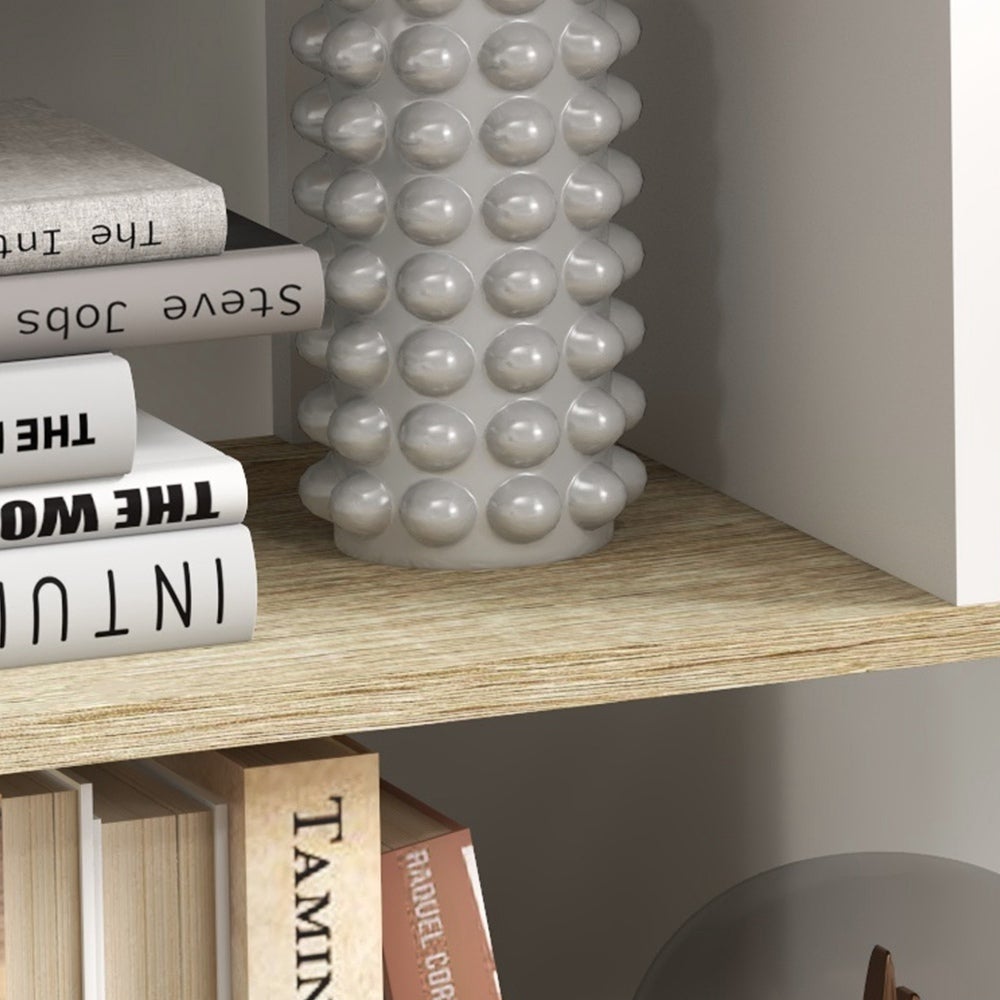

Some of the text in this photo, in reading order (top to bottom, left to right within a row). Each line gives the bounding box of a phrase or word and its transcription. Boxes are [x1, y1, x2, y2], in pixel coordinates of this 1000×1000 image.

[0, 220, 162, 259] The Int
[17, 284, 302, 339] Steve Jobs
[16, 412, 96, 453] THE
[0, 481, 220, 541] THE WO
